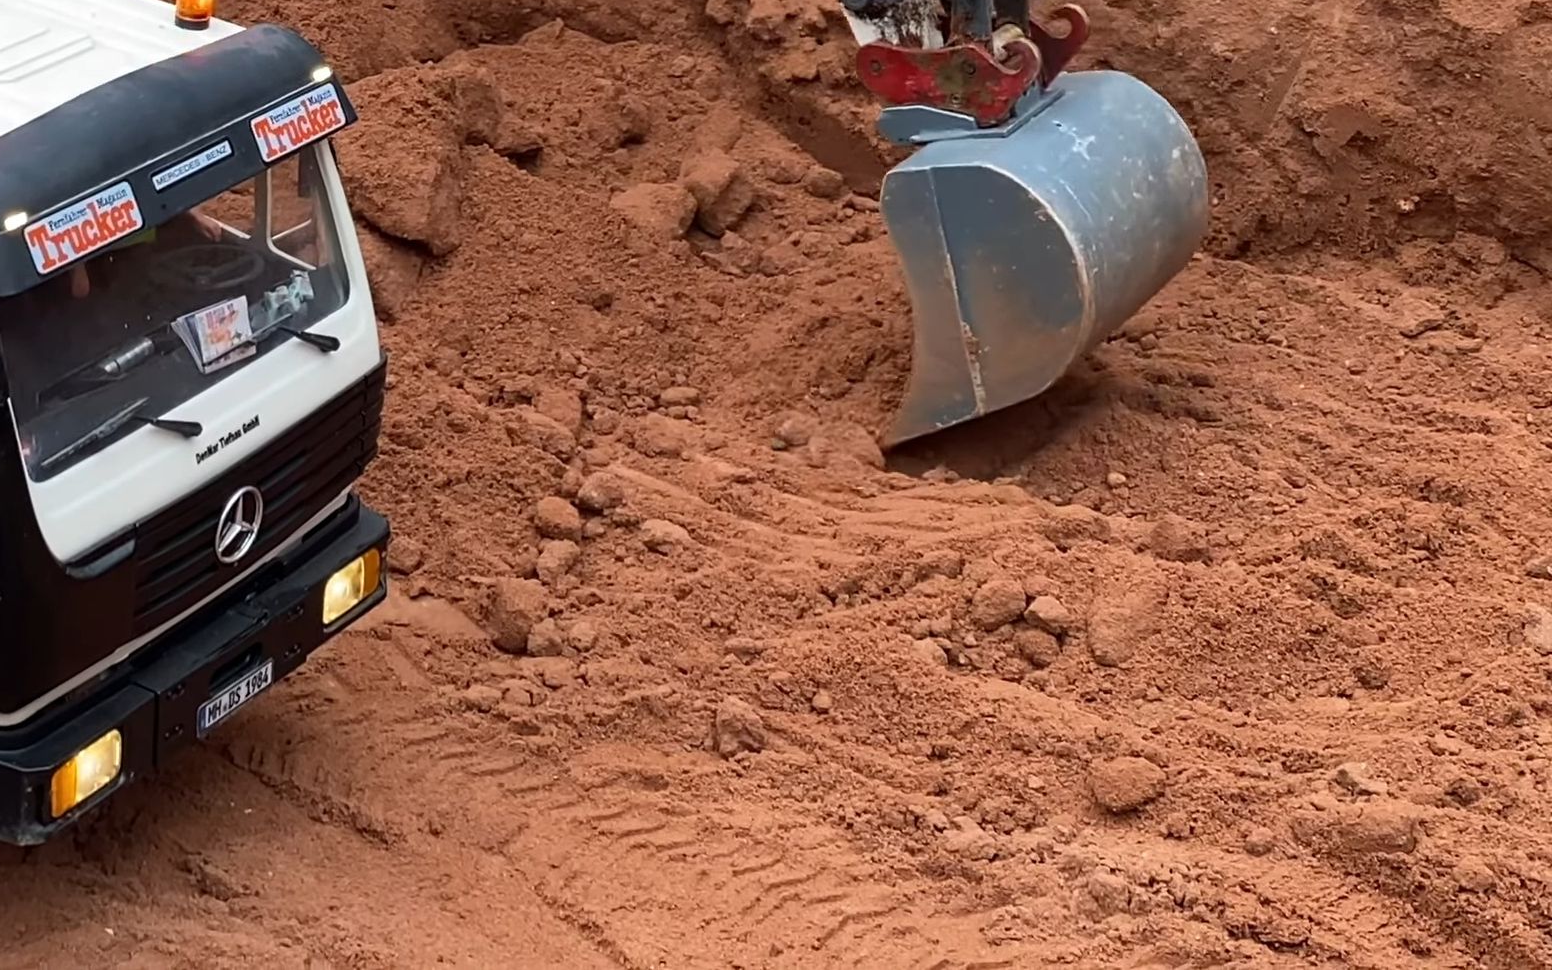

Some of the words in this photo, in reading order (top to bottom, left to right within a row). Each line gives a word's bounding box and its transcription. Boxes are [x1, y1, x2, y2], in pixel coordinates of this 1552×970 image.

[253, 98, 342, 160] Trucker
[28, 199, 138, 271] Trucker
[244, 667, 269, 698] 1984
